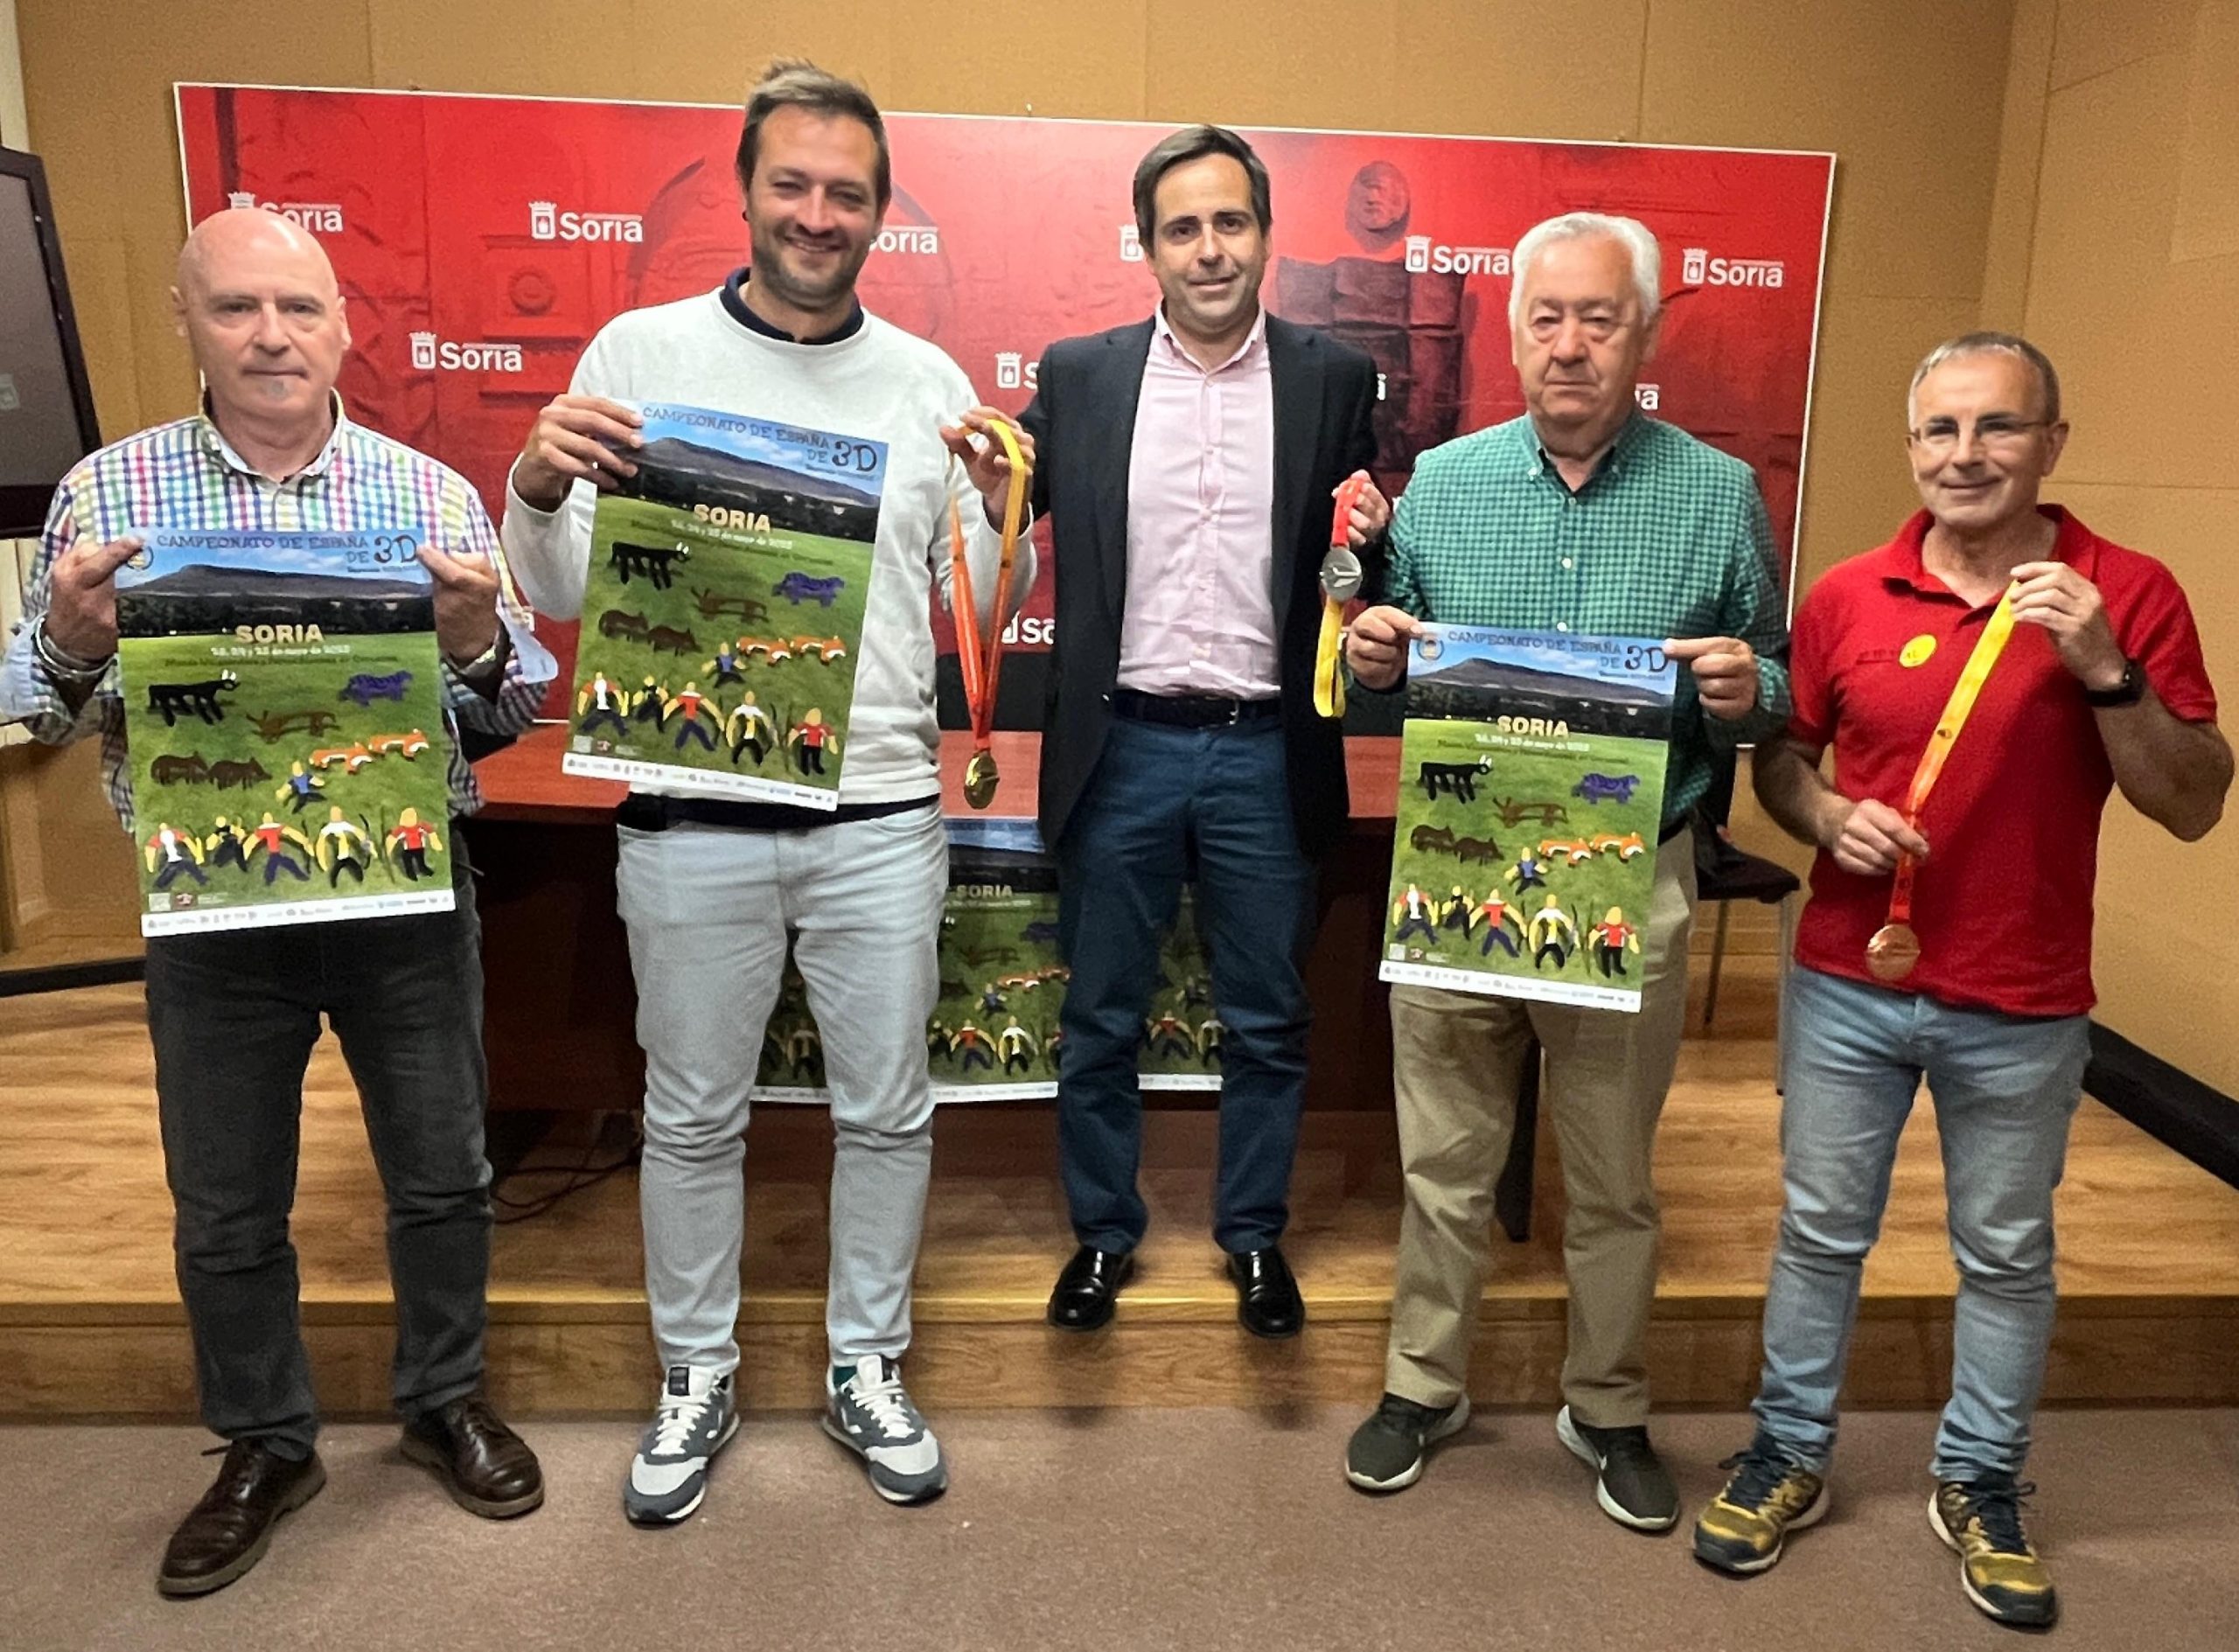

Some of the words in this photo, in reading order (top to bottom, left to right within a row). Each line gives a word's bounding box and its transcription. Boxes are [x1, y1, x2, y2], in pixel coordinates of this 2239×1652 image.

[261, 202, 344, 233] oria
[559, 212, 644, 242] Soria
[869, 226, 938, 254] oria
[1431, 245, 1510, 276] Soria
[1706, 259, 1784, 289] Soria
[439, 341, 523, 372] Soria
[643, 407, 746, 434] CAMPEONATO
[750, 423, 771, 438] DE
[776, 429, 829, 450] ESPAÑA
[806, 449, 828, 464] DE
[832, 440, 878, 472] 3D
[694, 504, 771, 534] SORIA
[157, 535, 275, 549] CAMPEONATO
[278, 536, 303, 549] DE
[309, 535, 368, 549] ESPAÑA
[345, 550, 370, 564] DE
[373, 534, 417, 563] 3D
[234, 624, 325, 644] SORIA
[1447, 631, 1542, 648] CAMPEONATO
[1545, 638, 1566, 652] DE
[1570, 640, 1622, 655] ESPAÑA
[1599, 656, 1621, 669] DE
[1624, 645, 1669, 673] 3D
[1496, 714, 1570, 738] SORIA
[956, 884, 1013, 898] SORIA
